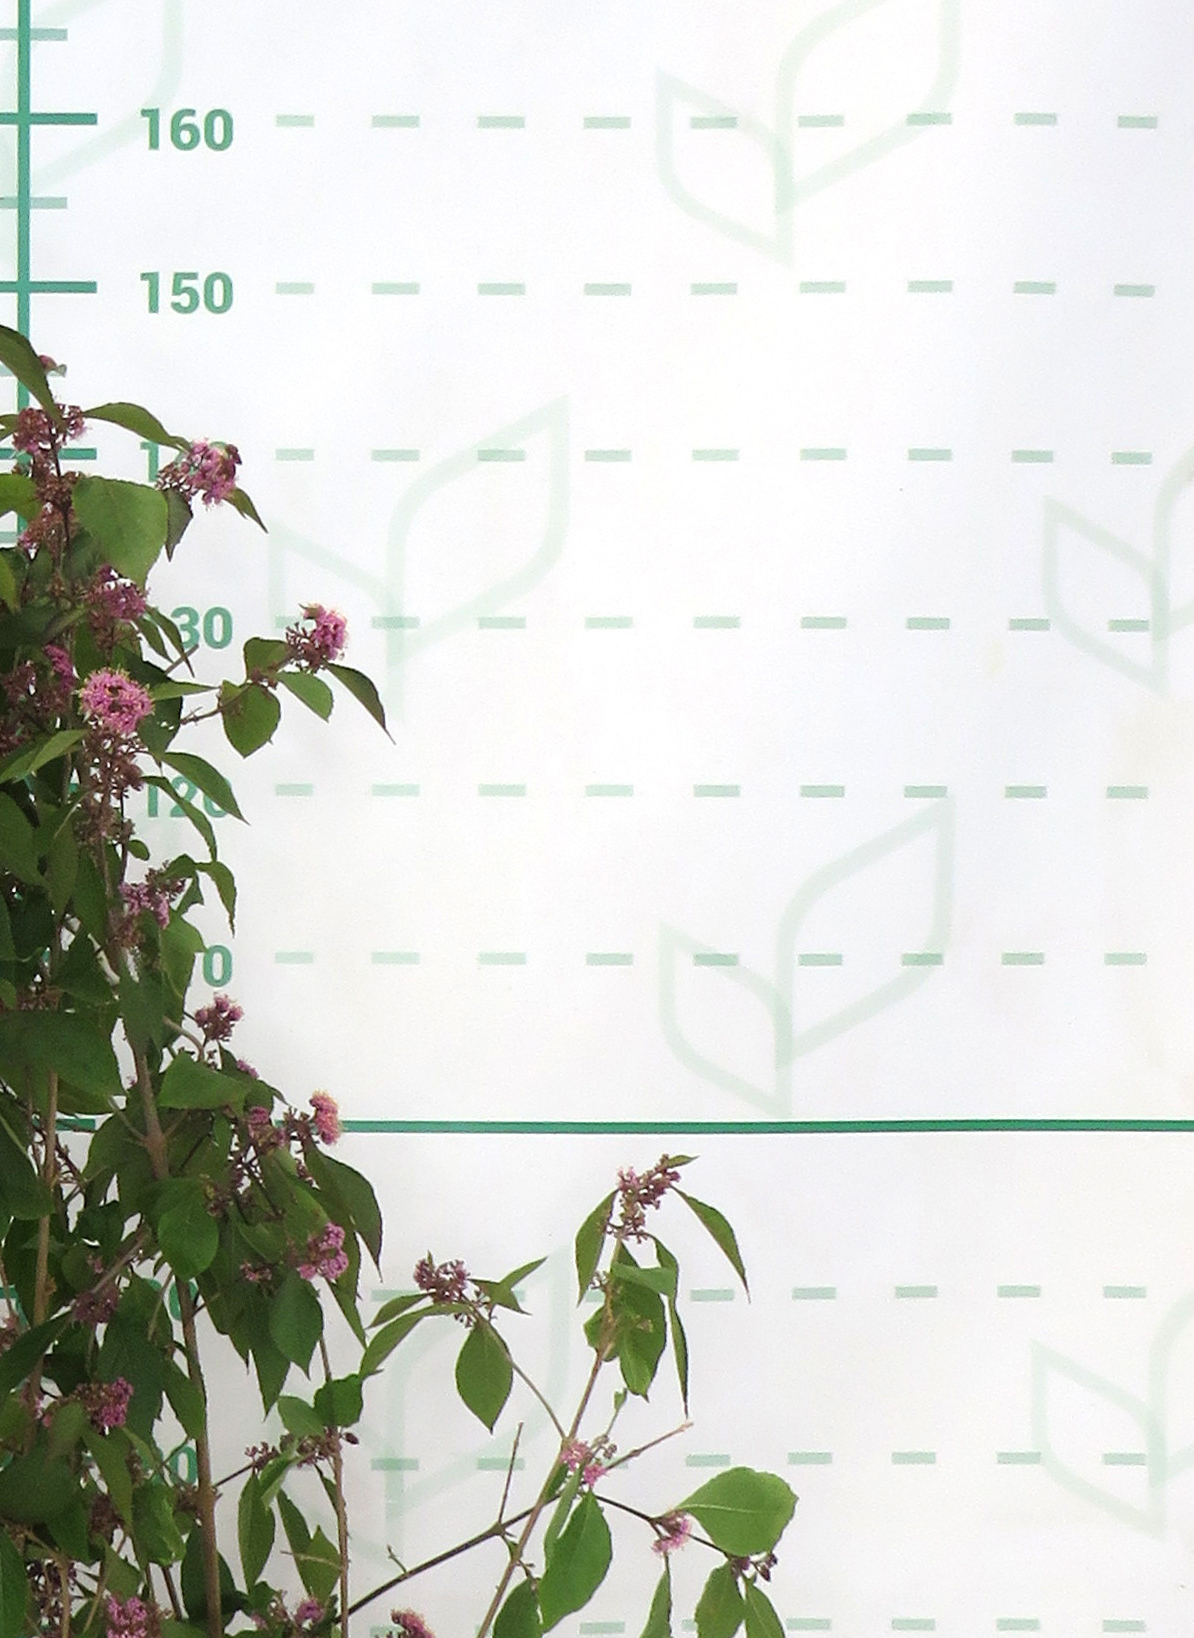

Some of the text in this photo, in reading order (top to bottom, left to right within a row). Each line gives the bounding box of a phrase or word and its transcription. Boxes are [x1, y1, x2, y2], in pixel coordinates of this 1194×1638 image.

[140, 108, 234, 151] 160
[140, 271, 234, 314] 150
[143, 606, 233, 649] 30
